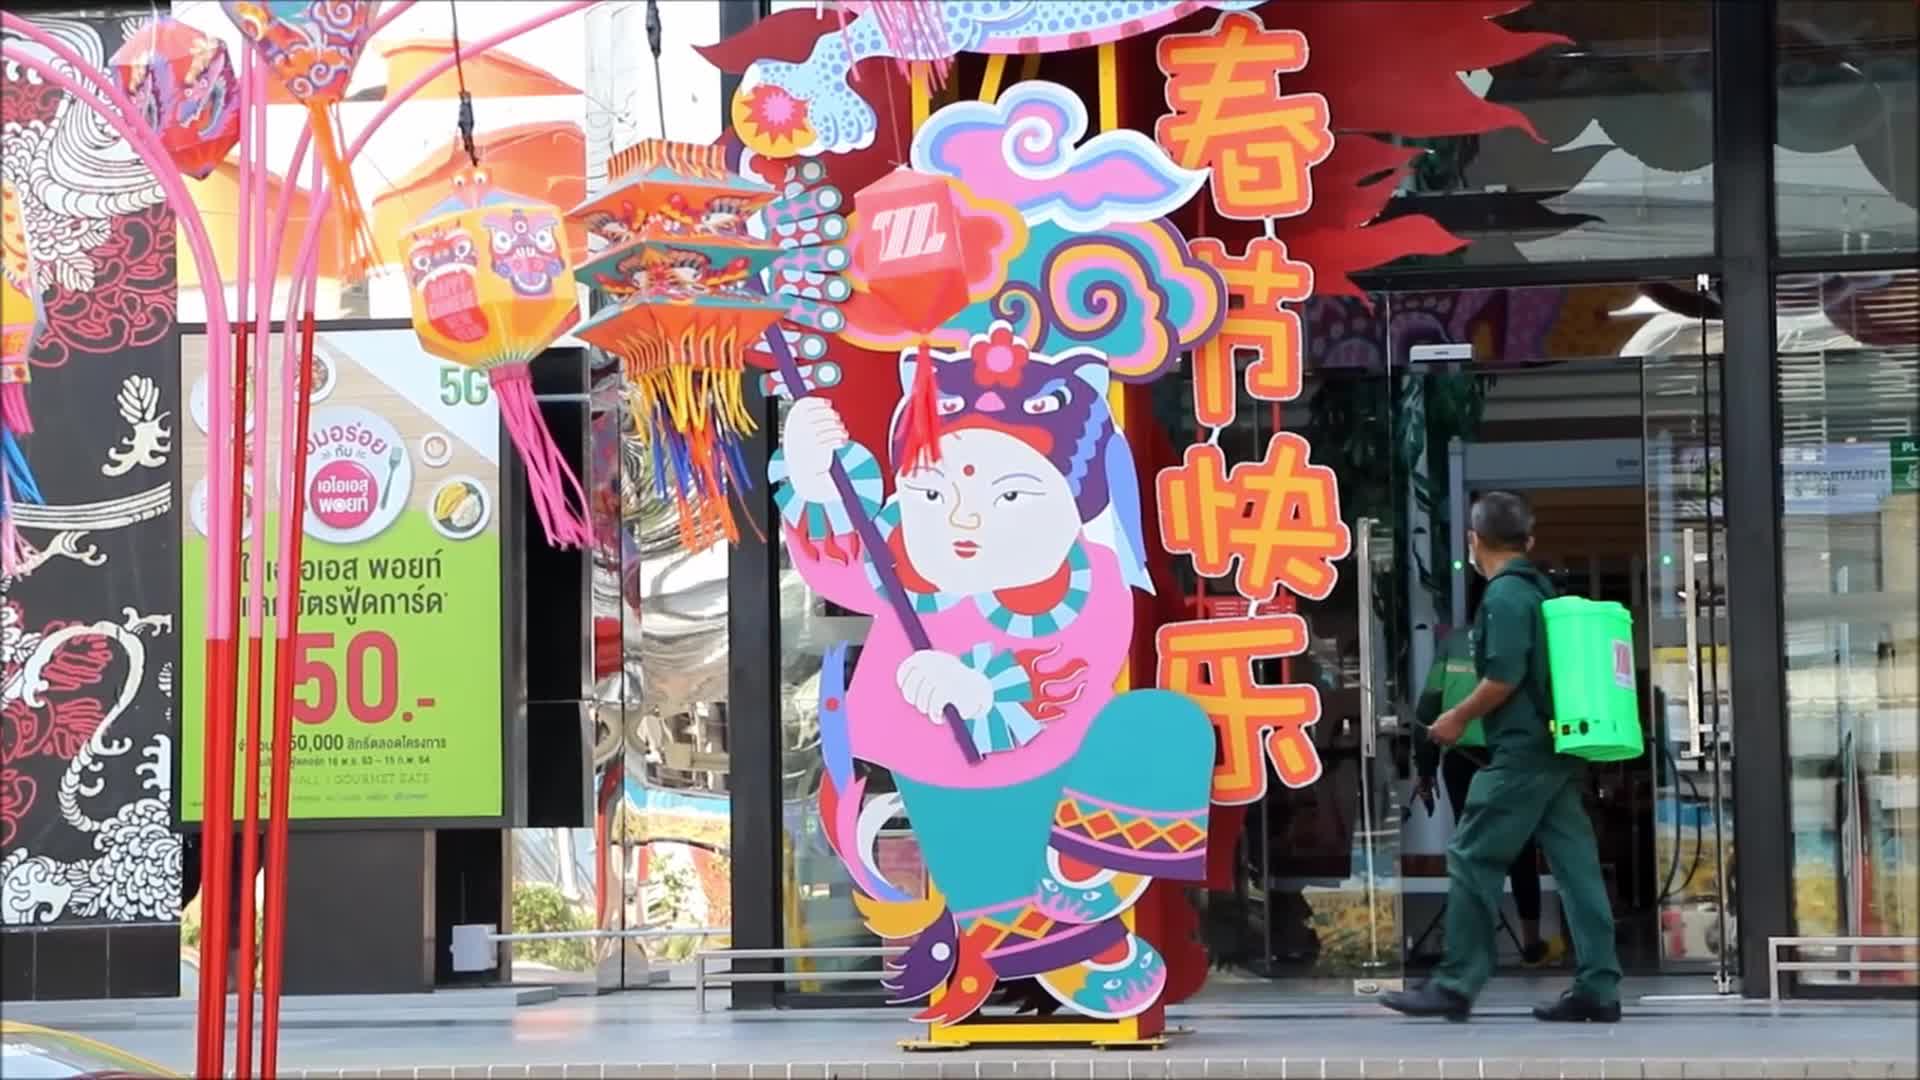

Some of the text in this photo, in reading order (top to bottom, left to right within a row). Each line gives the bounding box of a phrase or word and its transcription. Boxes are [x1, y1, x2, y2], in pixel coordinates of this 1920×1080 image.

[439, 367, 489, 405] 5G
[1155, 10, 1351, 805] 春节快乐
[317, 475, 368, 493] เอไอเอส
[369, 549, 443, 579] พอยท์
